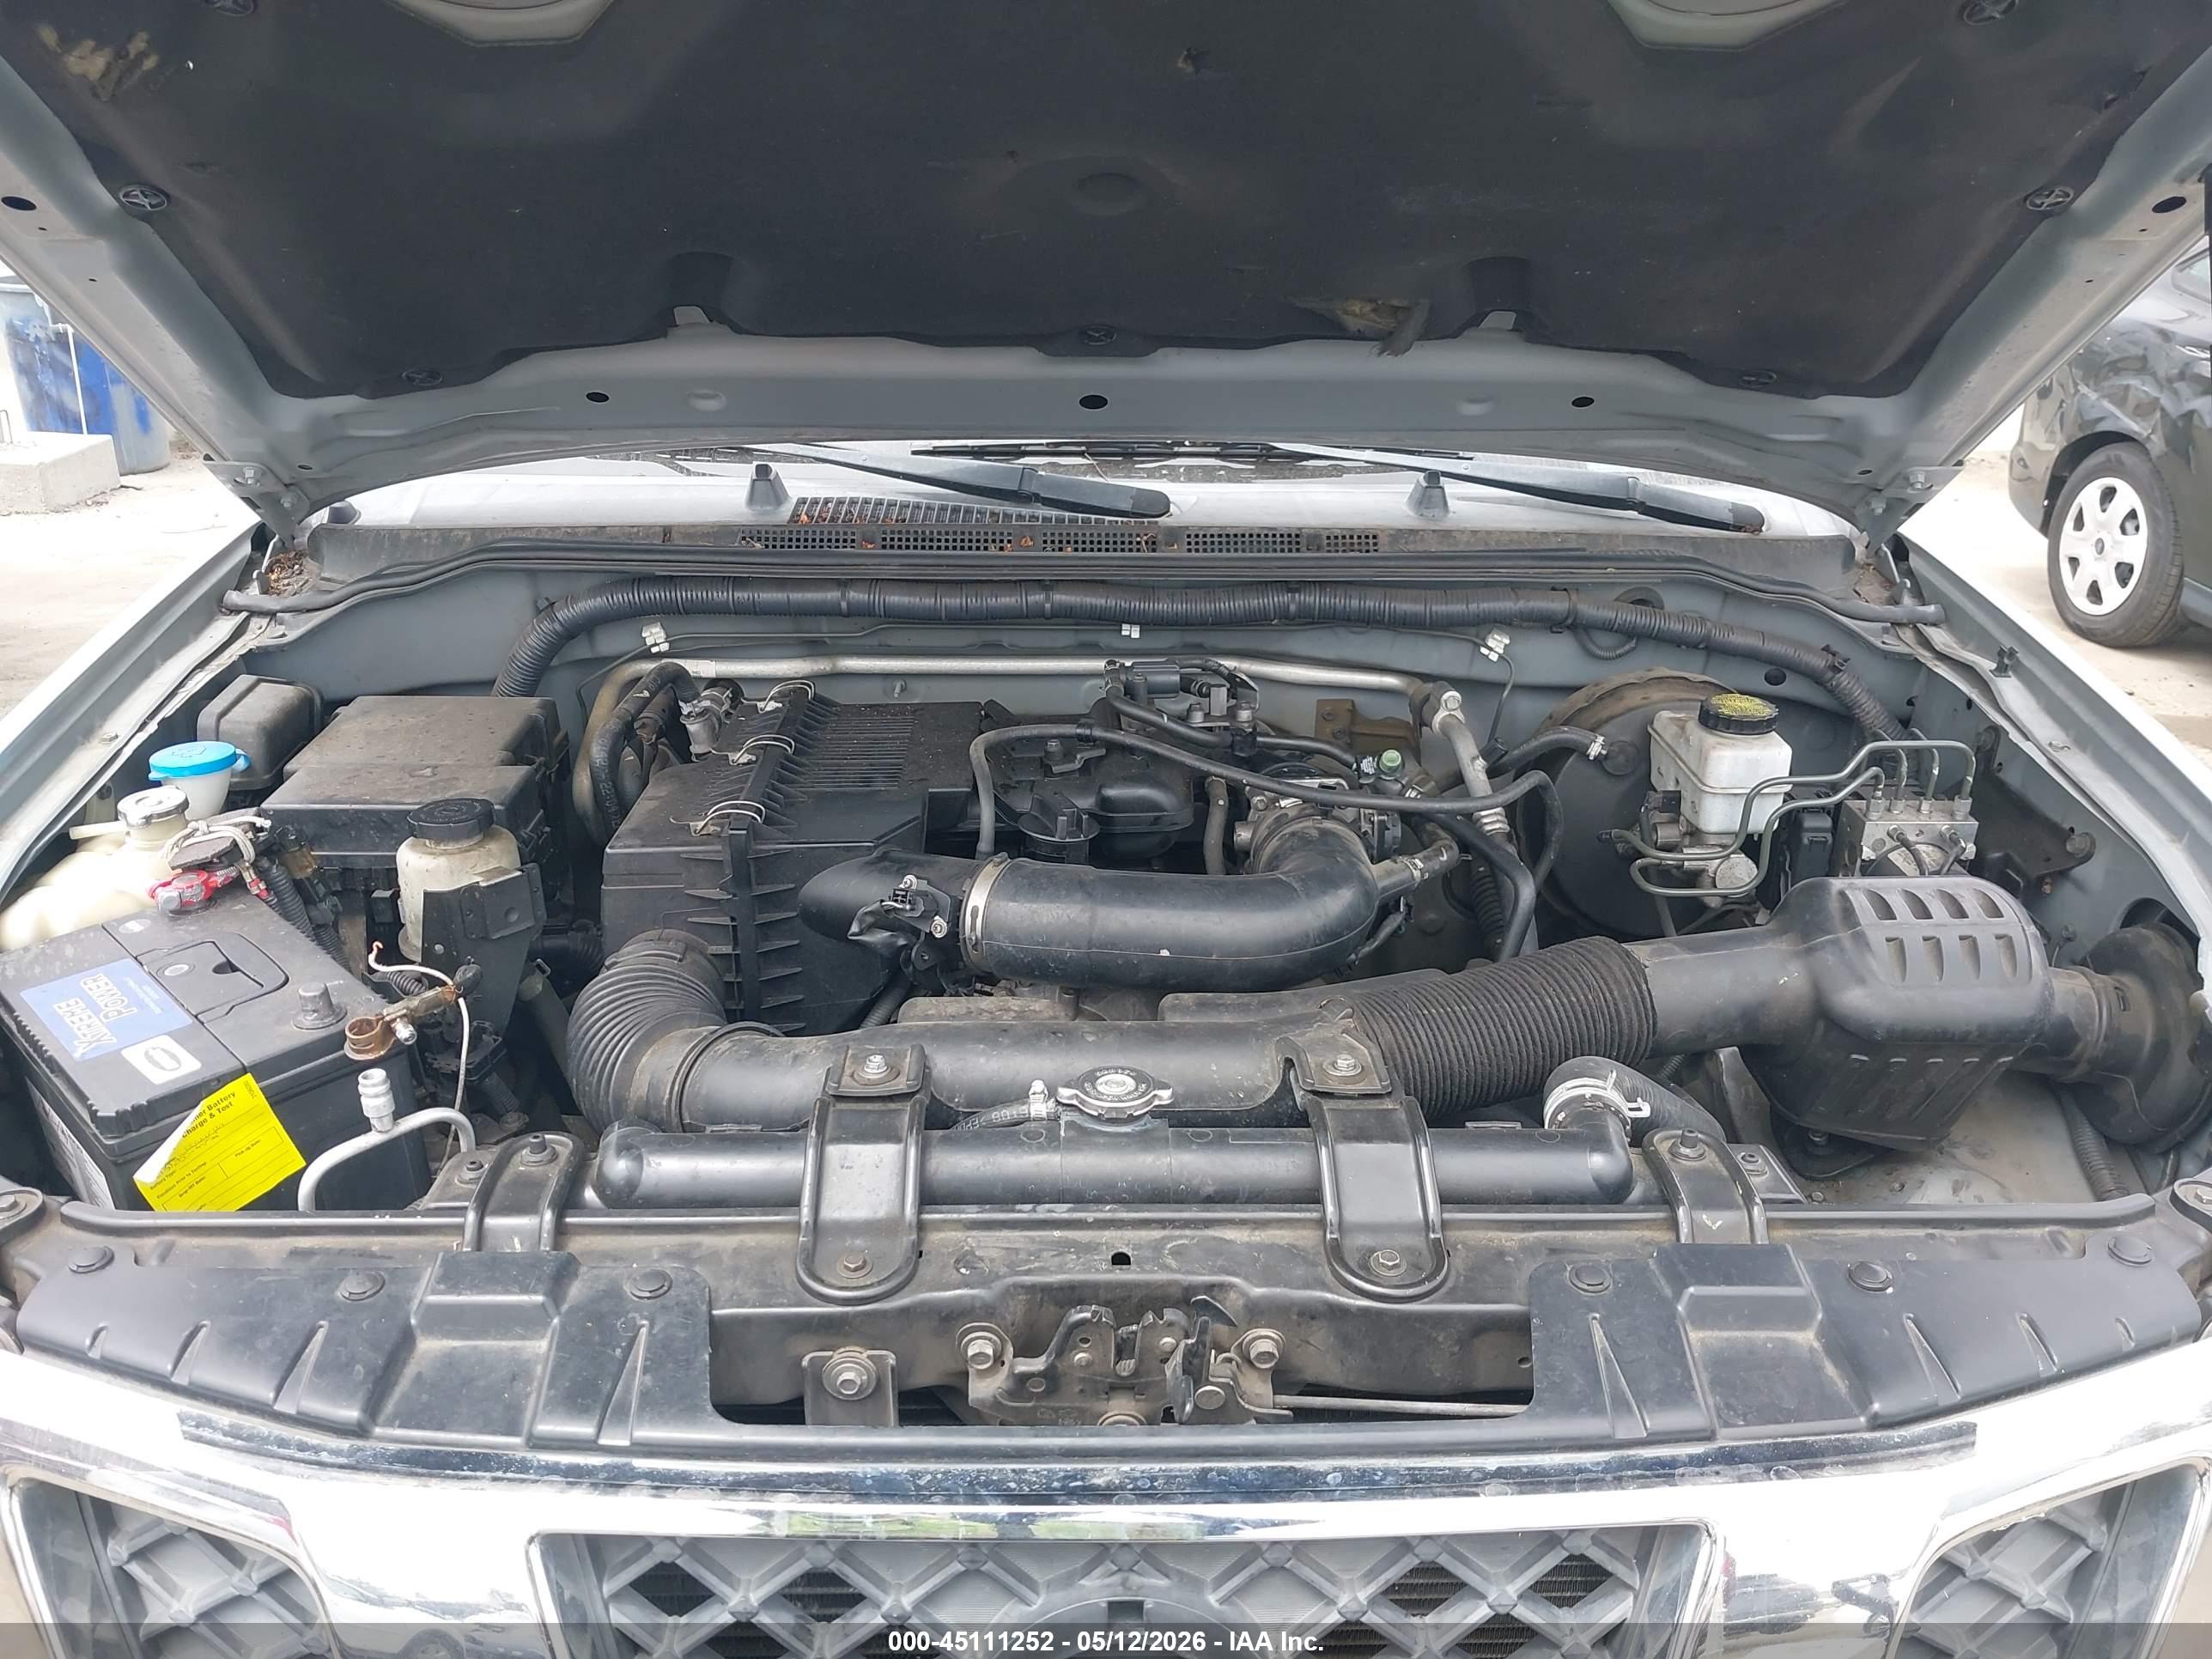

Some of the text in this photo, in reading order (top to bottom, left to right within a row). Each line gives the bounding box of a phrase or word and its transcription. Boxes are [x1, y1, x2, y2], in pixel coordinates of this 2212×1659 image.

[80, 973, 137, 1023] POWER
[207, 1091, 236, 1110] Battery
[182, 1117, 208, 1139] Charge
[216, 1102, 234, 1114] Test
